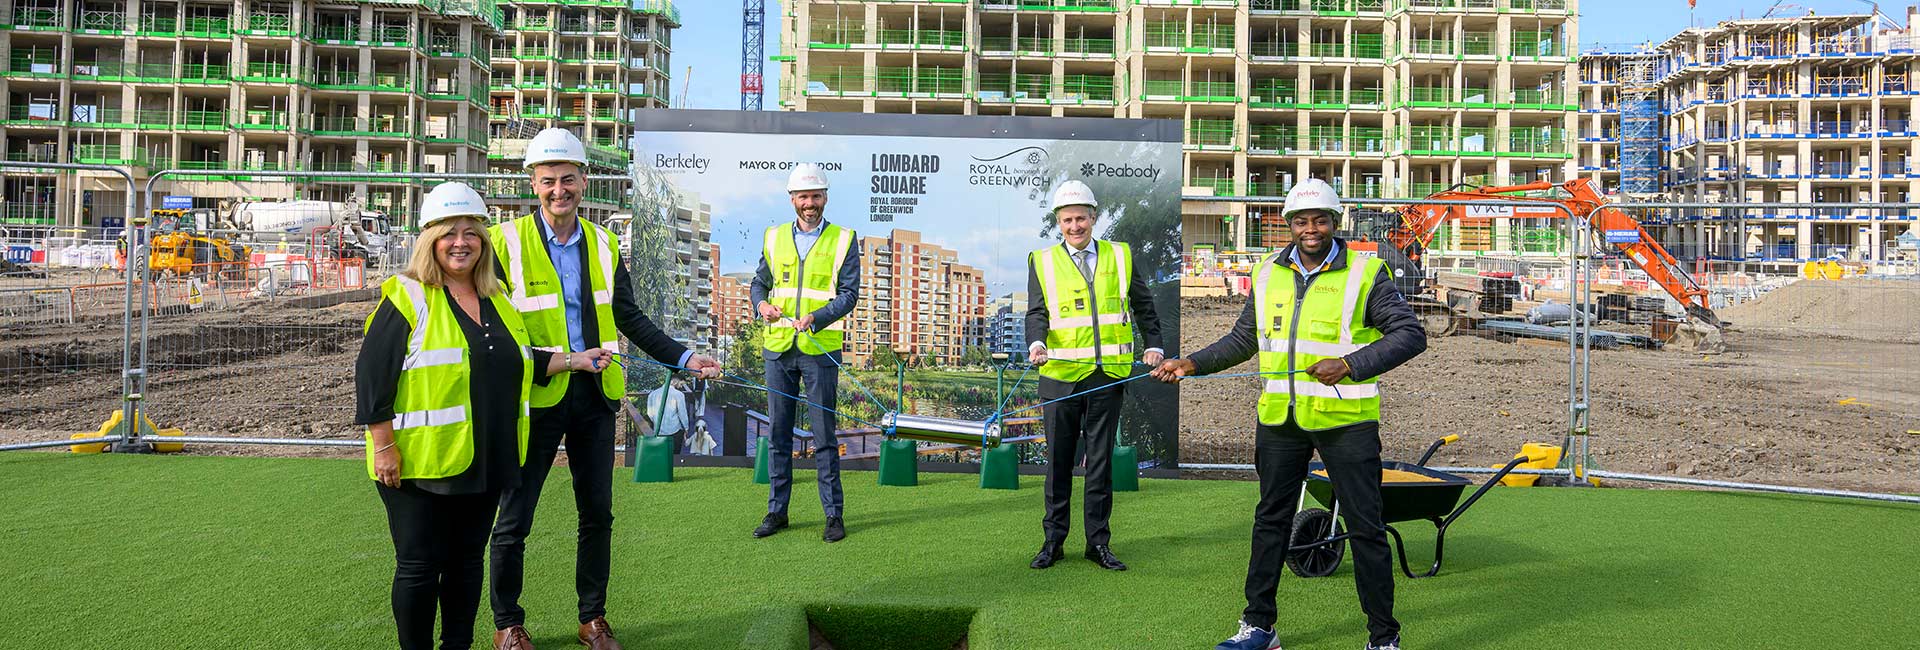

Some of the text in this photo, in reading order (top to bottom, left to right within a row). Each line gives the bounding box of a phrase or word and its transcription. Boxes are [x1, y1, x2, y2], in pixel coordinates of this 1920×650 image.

[656, 153, 711, 174] Berkeley
[739, 161, 776, 170] MAYOR
[779, 161, 793, 170] OF
[871, 153, 940, 173] LOMBARD
[969, 164, 1010, 174] ROYAL
[1098, 163, 1161, 182] Peabody
[871, 175, 927, 194] SQUARE
[969, 175, 1051, 187] GREENWICH
[870, 197, 918, 206] ROYAL BOROUGH
[870, 205, 914, 214] OF GREENWICH
[870, 214, 893, 222] LONDON
